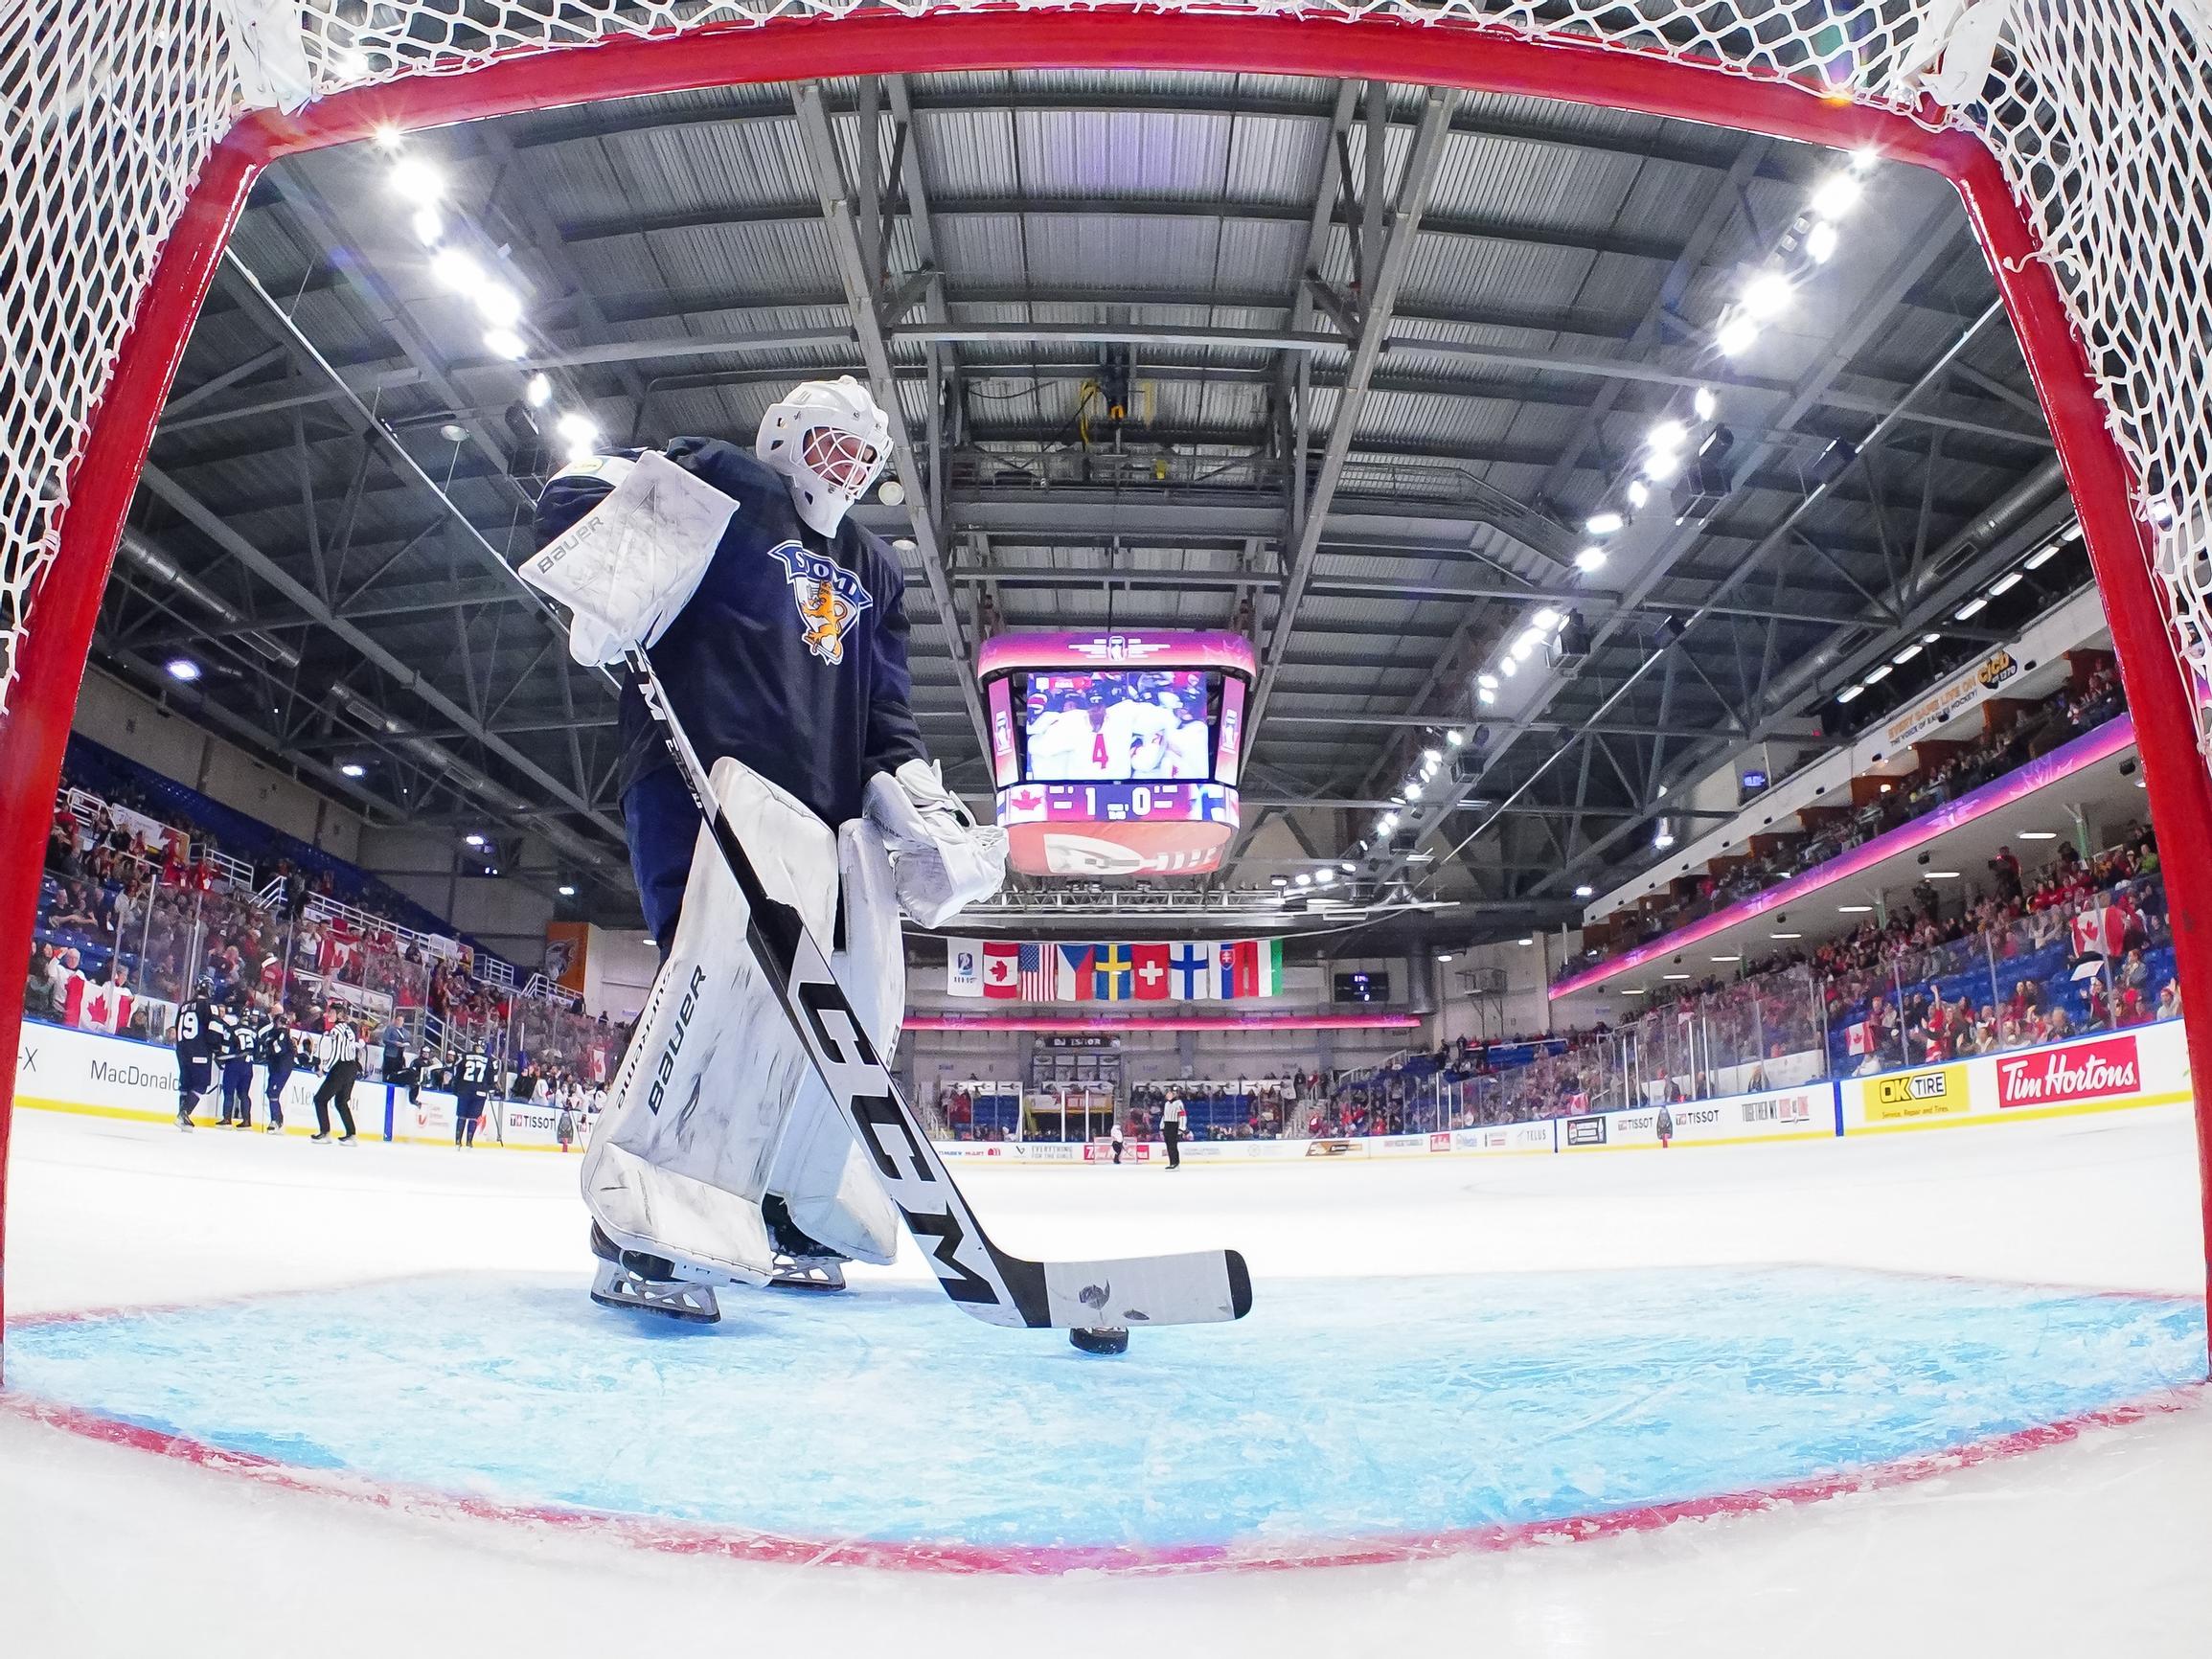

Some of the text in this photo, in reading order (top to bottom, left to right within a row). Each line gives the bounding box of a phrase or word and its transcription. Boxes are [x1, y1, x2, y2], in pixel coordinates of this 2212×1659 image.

[1092, 733, 1108, 769] 4
[1085, 786, 1096, 816] 1
[1131, 786, 1152, 816] 0
[177, 1011, 199, 1042] 19
[463, 1060, 487, 1083] 27
[2001, 1053, 2135, 1102] Tim Hortons
[1880, 1076, 1944, 1103] OK TIRE
[523, 1115, 556, 1130] TISSOT
[1629, 1117, 1653, 1130] TISSOT
[1688, 1109, 1720, 1125] TISSOT
[798, 981, 1001, 1306] CCM
[1526, 1128, 1546, 1142] TELUS
